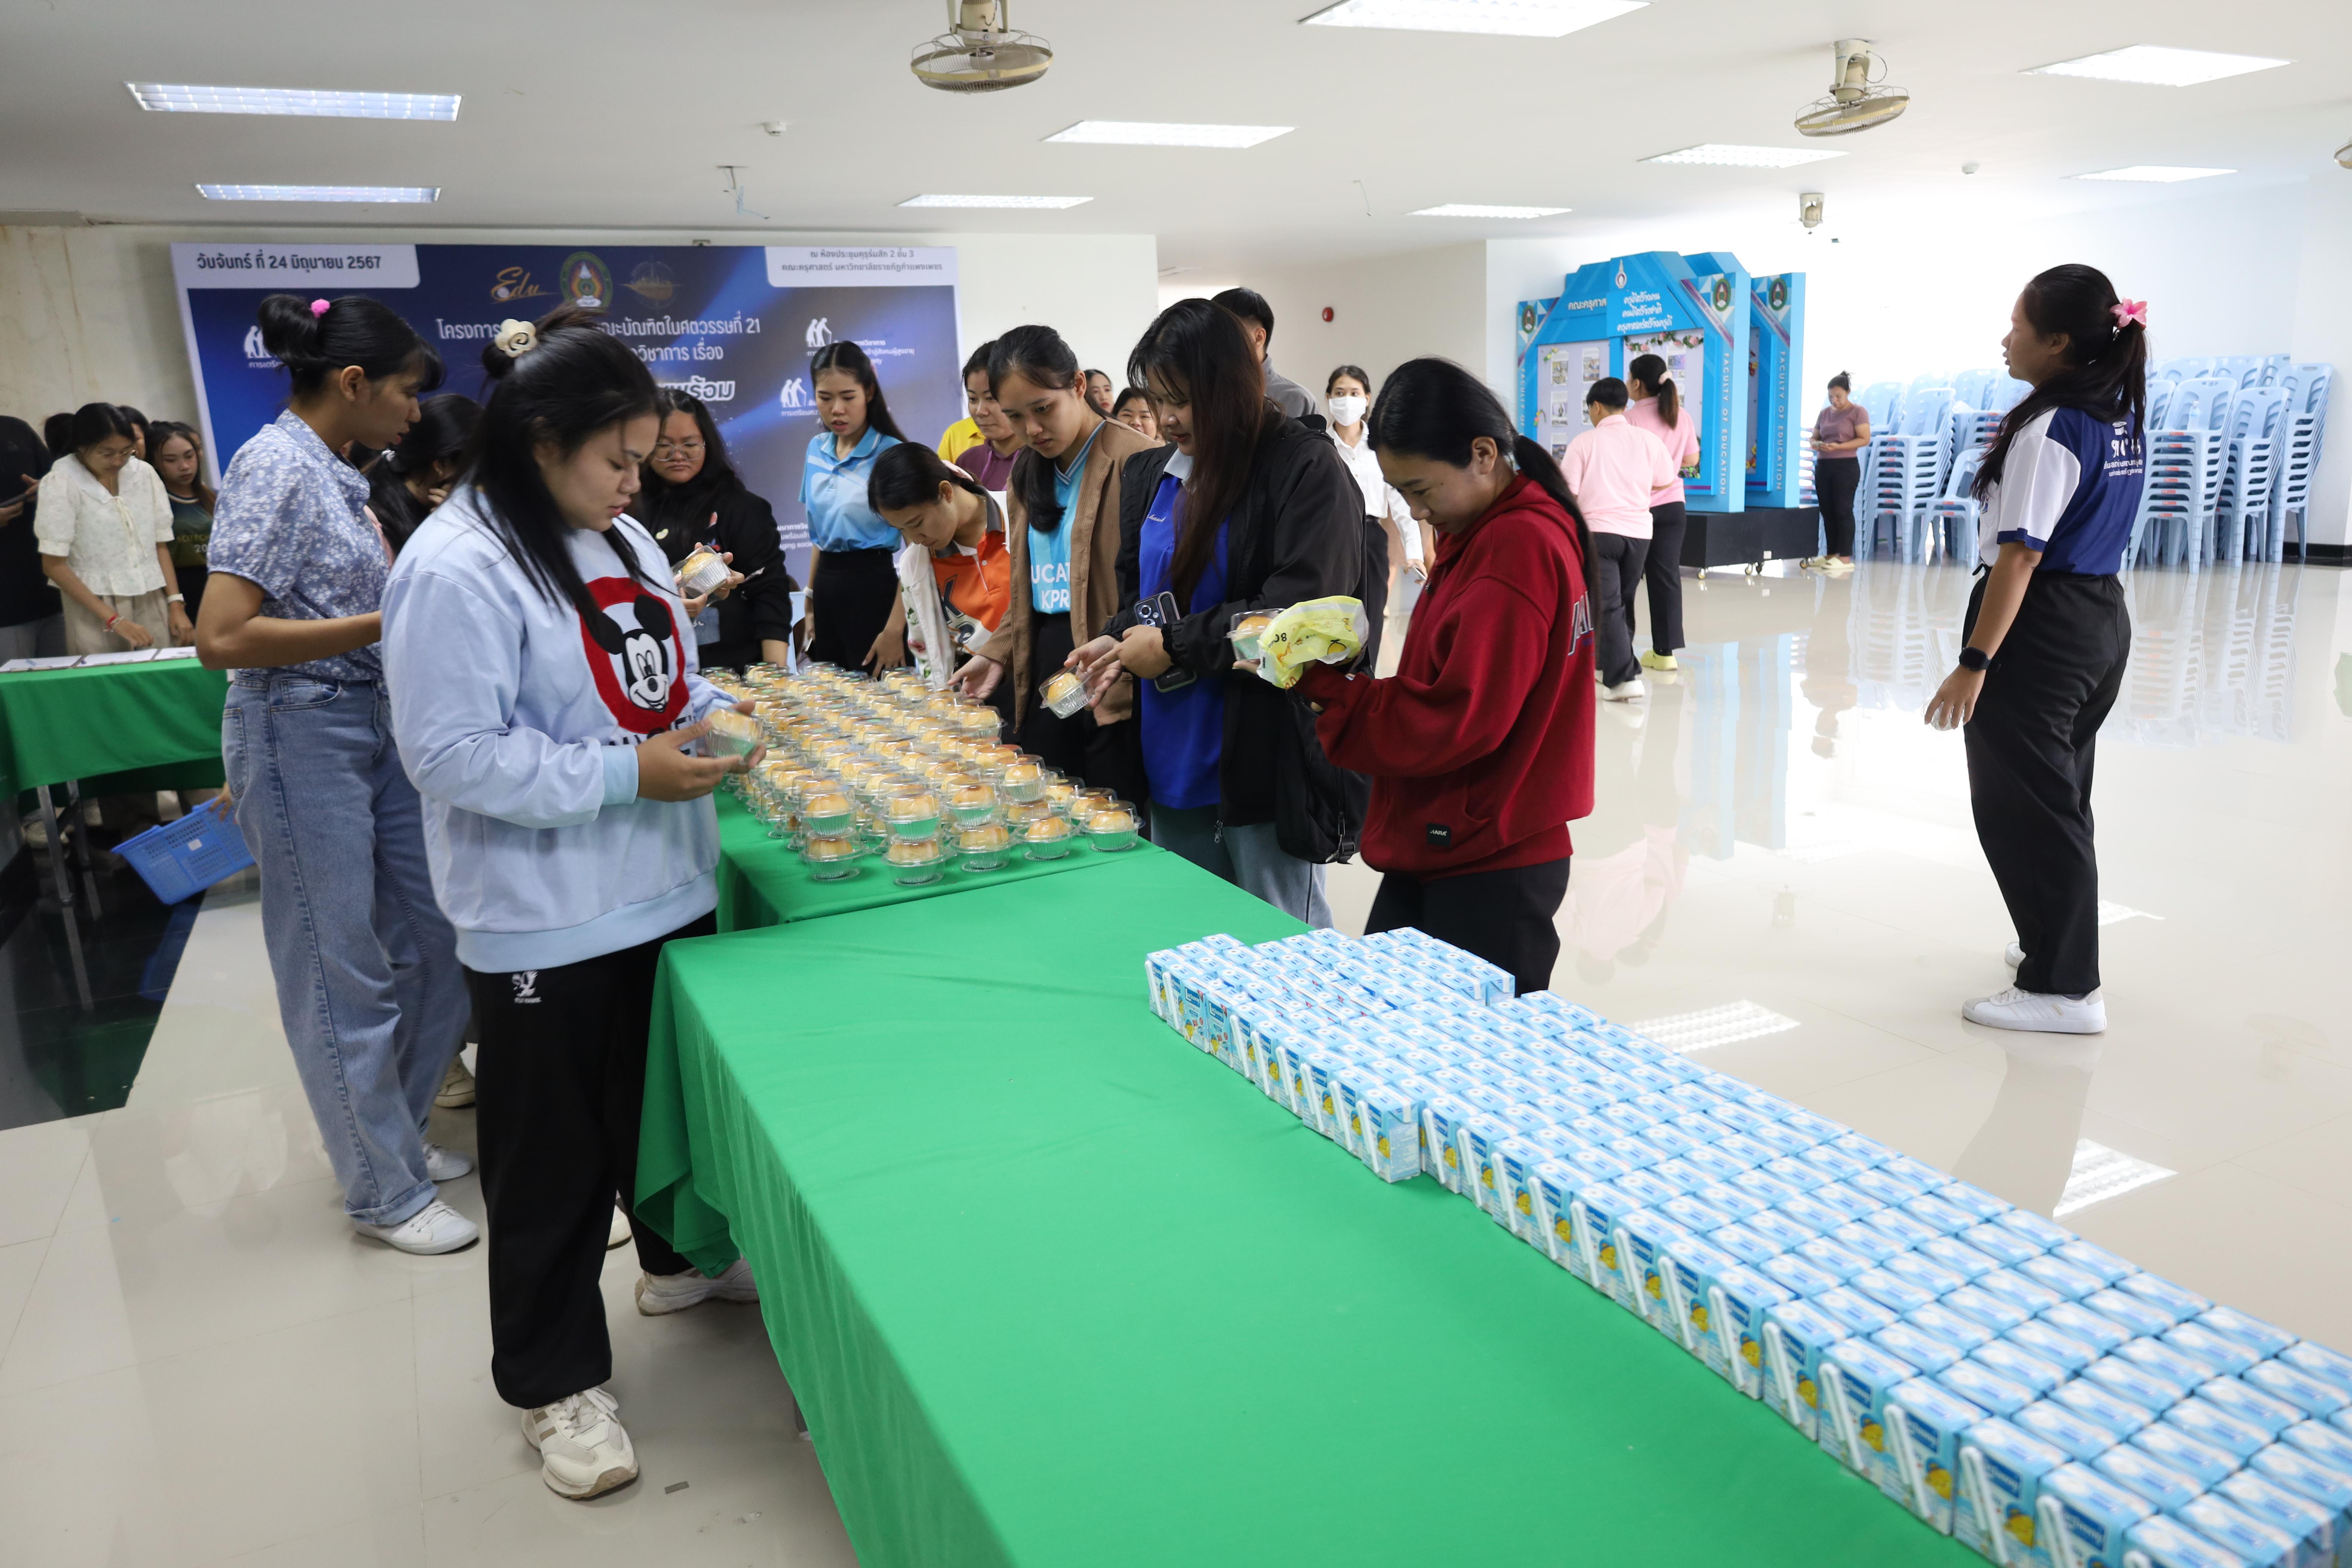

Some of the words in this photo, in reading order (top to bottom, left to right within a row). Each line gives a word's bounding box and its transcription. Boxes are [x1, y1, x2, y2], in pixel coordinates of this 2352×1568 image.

[197, 253, 253, 269] วันจันทร์
[256, 249, 265, 269] ที่
[269, 256, 287, 269] 24
[291, 254, 344, 273] มิถุนายน
[348, 256, 381, 269] 2567
[491, 266, 558, 303] Edu
[600, 311, 743, 337] ณะบัณฑิตในศตวรรษที่
[746, 317, 761, 334] 21
[693, 337, 724, 360] เรื่อง
[1722, 408, 1728, 422] OF
[1778, 405, 1784, 419] OF
[1041, 589, 1070, 609] KPR
